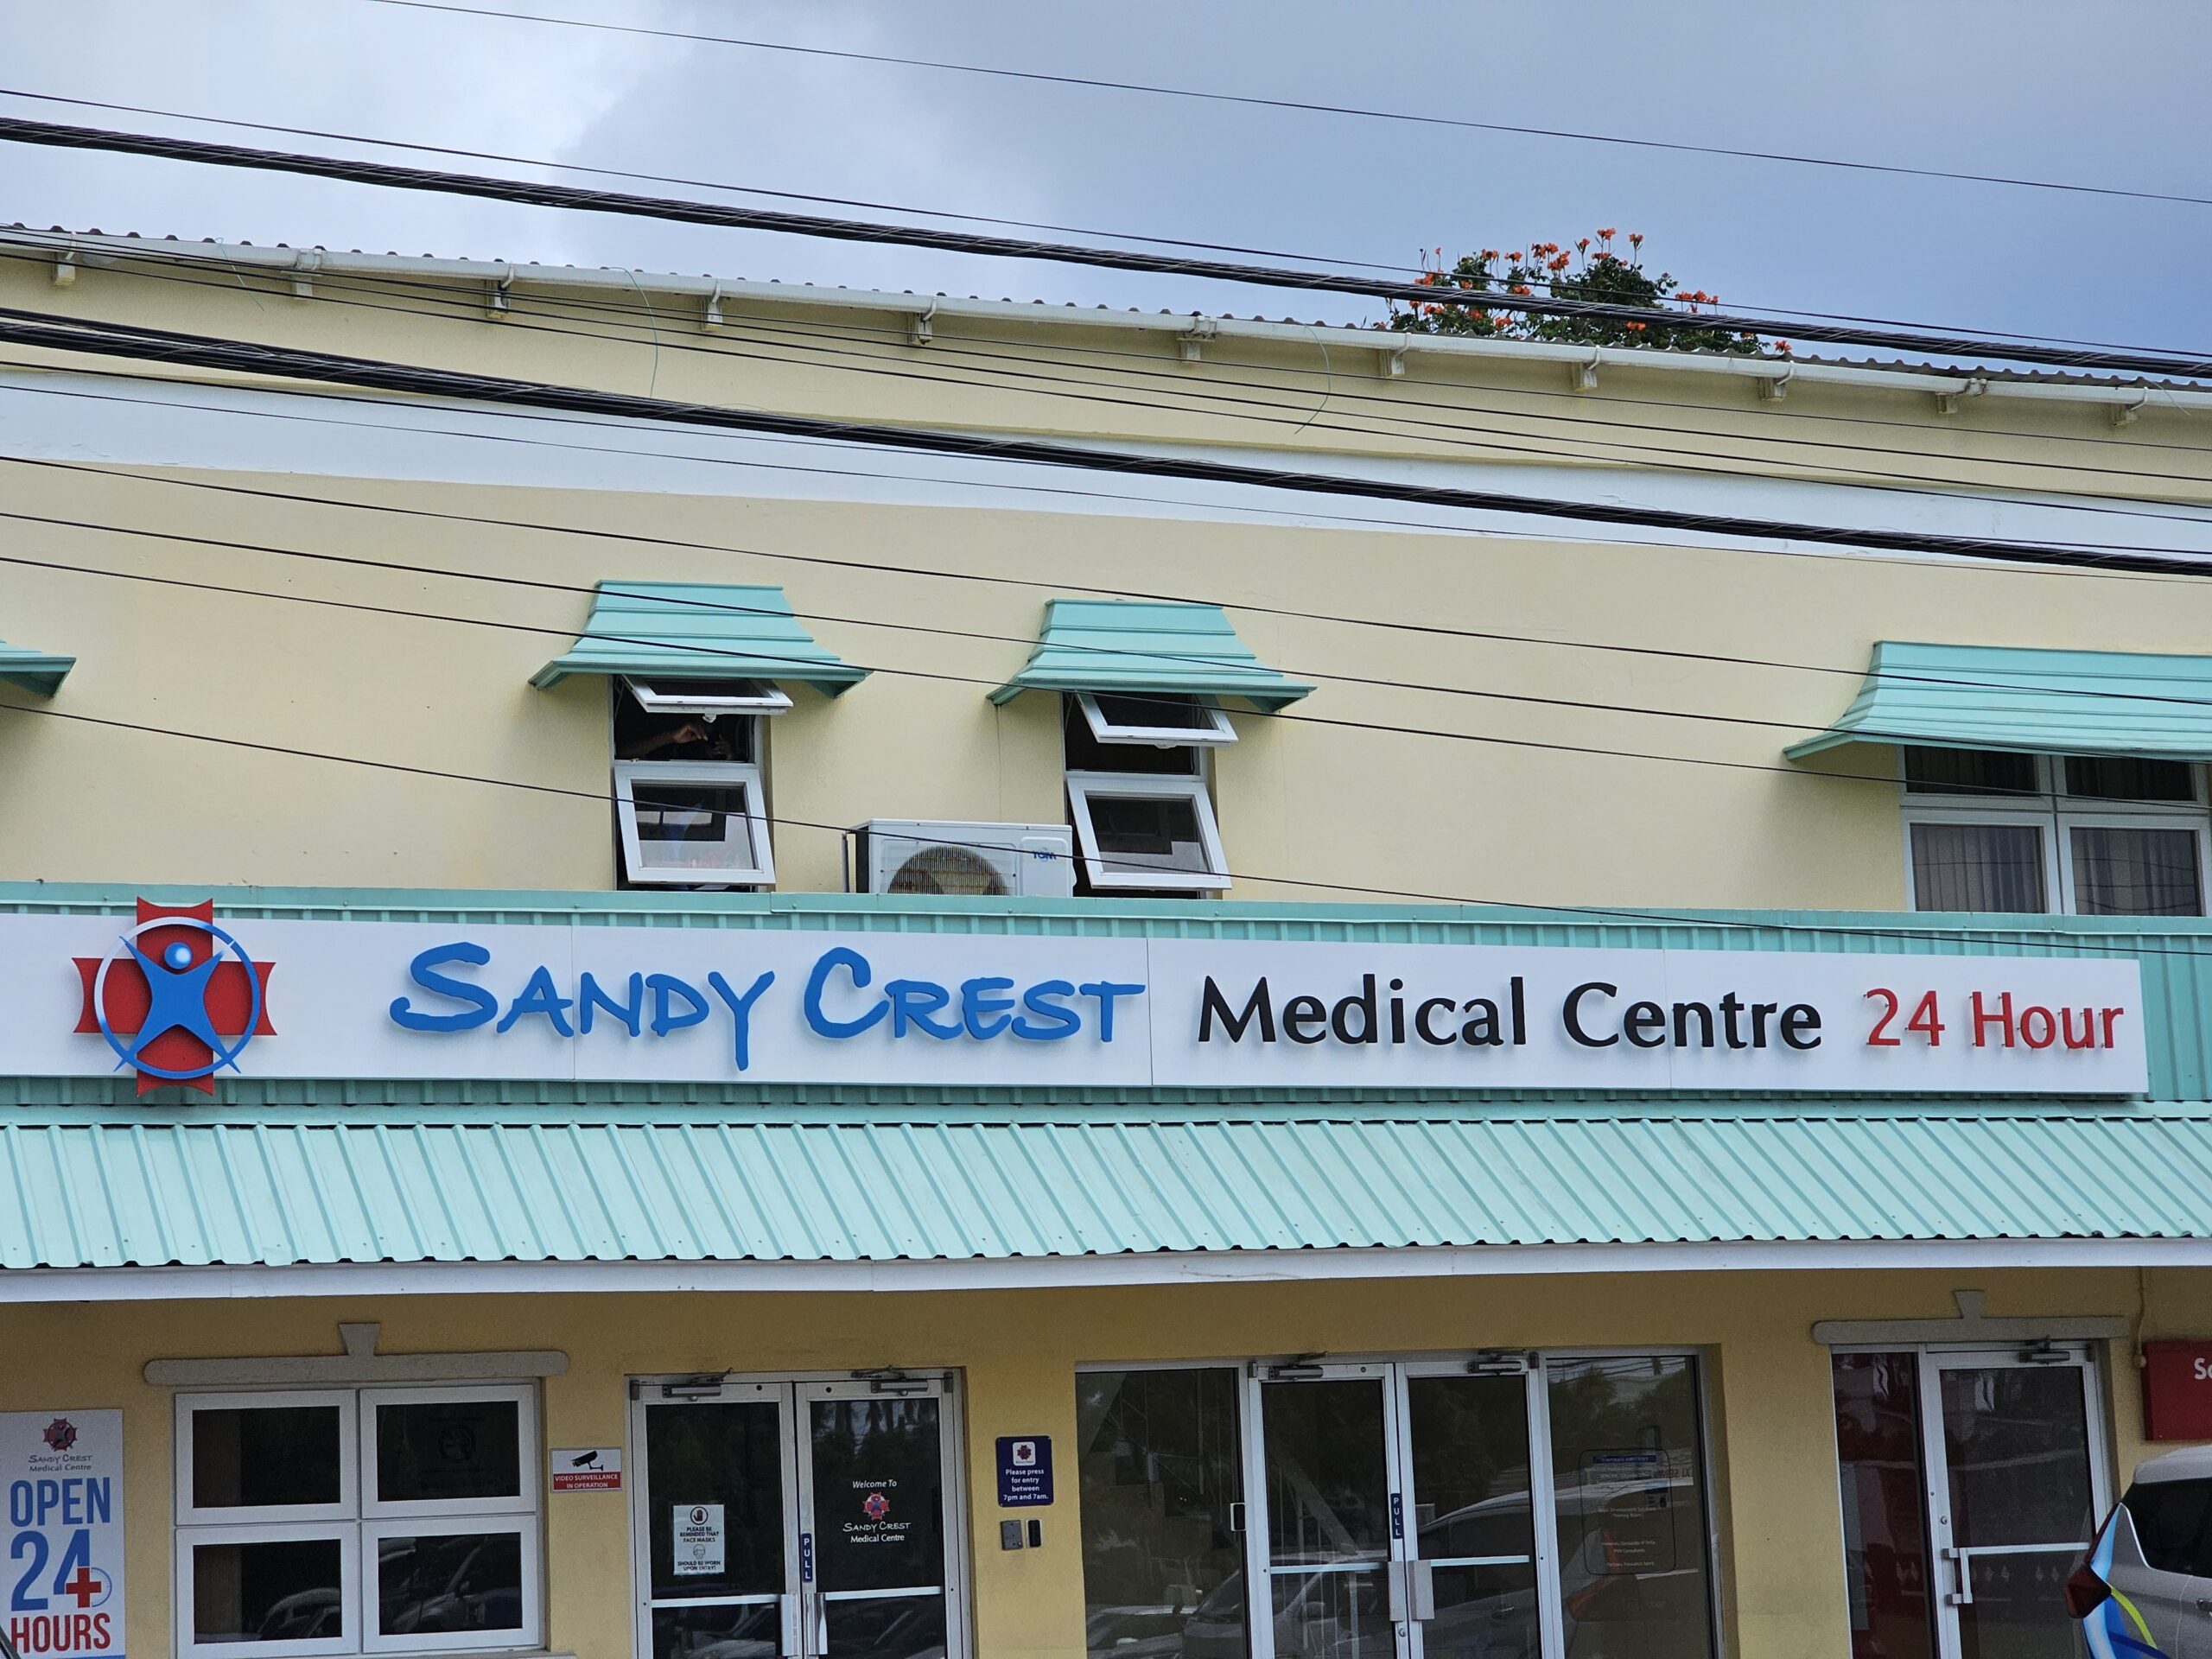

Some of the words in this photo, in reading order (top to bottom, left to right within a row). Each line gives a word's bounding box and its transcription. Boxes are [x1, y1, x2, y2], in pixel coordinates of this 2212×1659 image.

[389, 941, 776, 1071] SANDY
[804, 946, 1147, 1043] CREST
[1198, 973, 1528, 1046] Medical
[1562, 981, 1822, 1050] Centre
[1865, 987, 1946, 1047] 24
[1969, 990, 2126, 1050] Hour
[10, 1477, 111, 1527] OPEN
[852, 1480, 887, 1489] Welcome
[888, 1478, 898, 1487] To
[1003, 1494, 1019, 1503] 7pm
[850, 1535, 880, 1543] Medical
[880, 1534, 905, 1542] Centre
[10, 1529, 102, 1611] 24
[10, 1612, 111, 1654] HOURS
